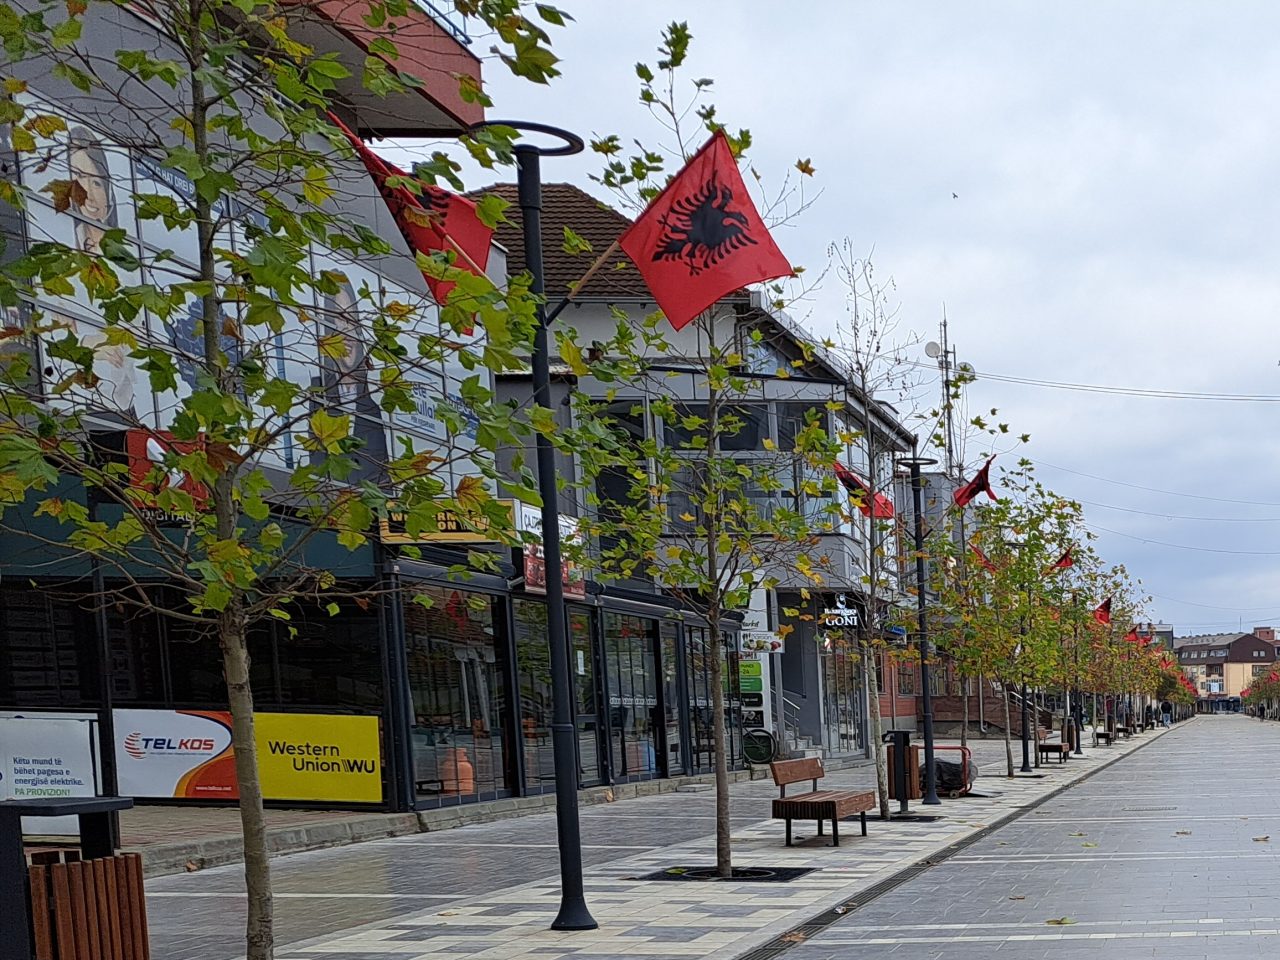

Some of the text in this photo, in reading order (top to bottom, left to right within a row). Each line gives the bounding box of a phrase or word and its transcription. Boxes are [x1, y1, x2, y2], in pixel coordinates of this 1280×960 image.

[268, 741, 340, 757] Western
[293, 757, 341, 772] Union
[37, 768, 64, 777] pagesa
[14, 788, 25, 796] PA
